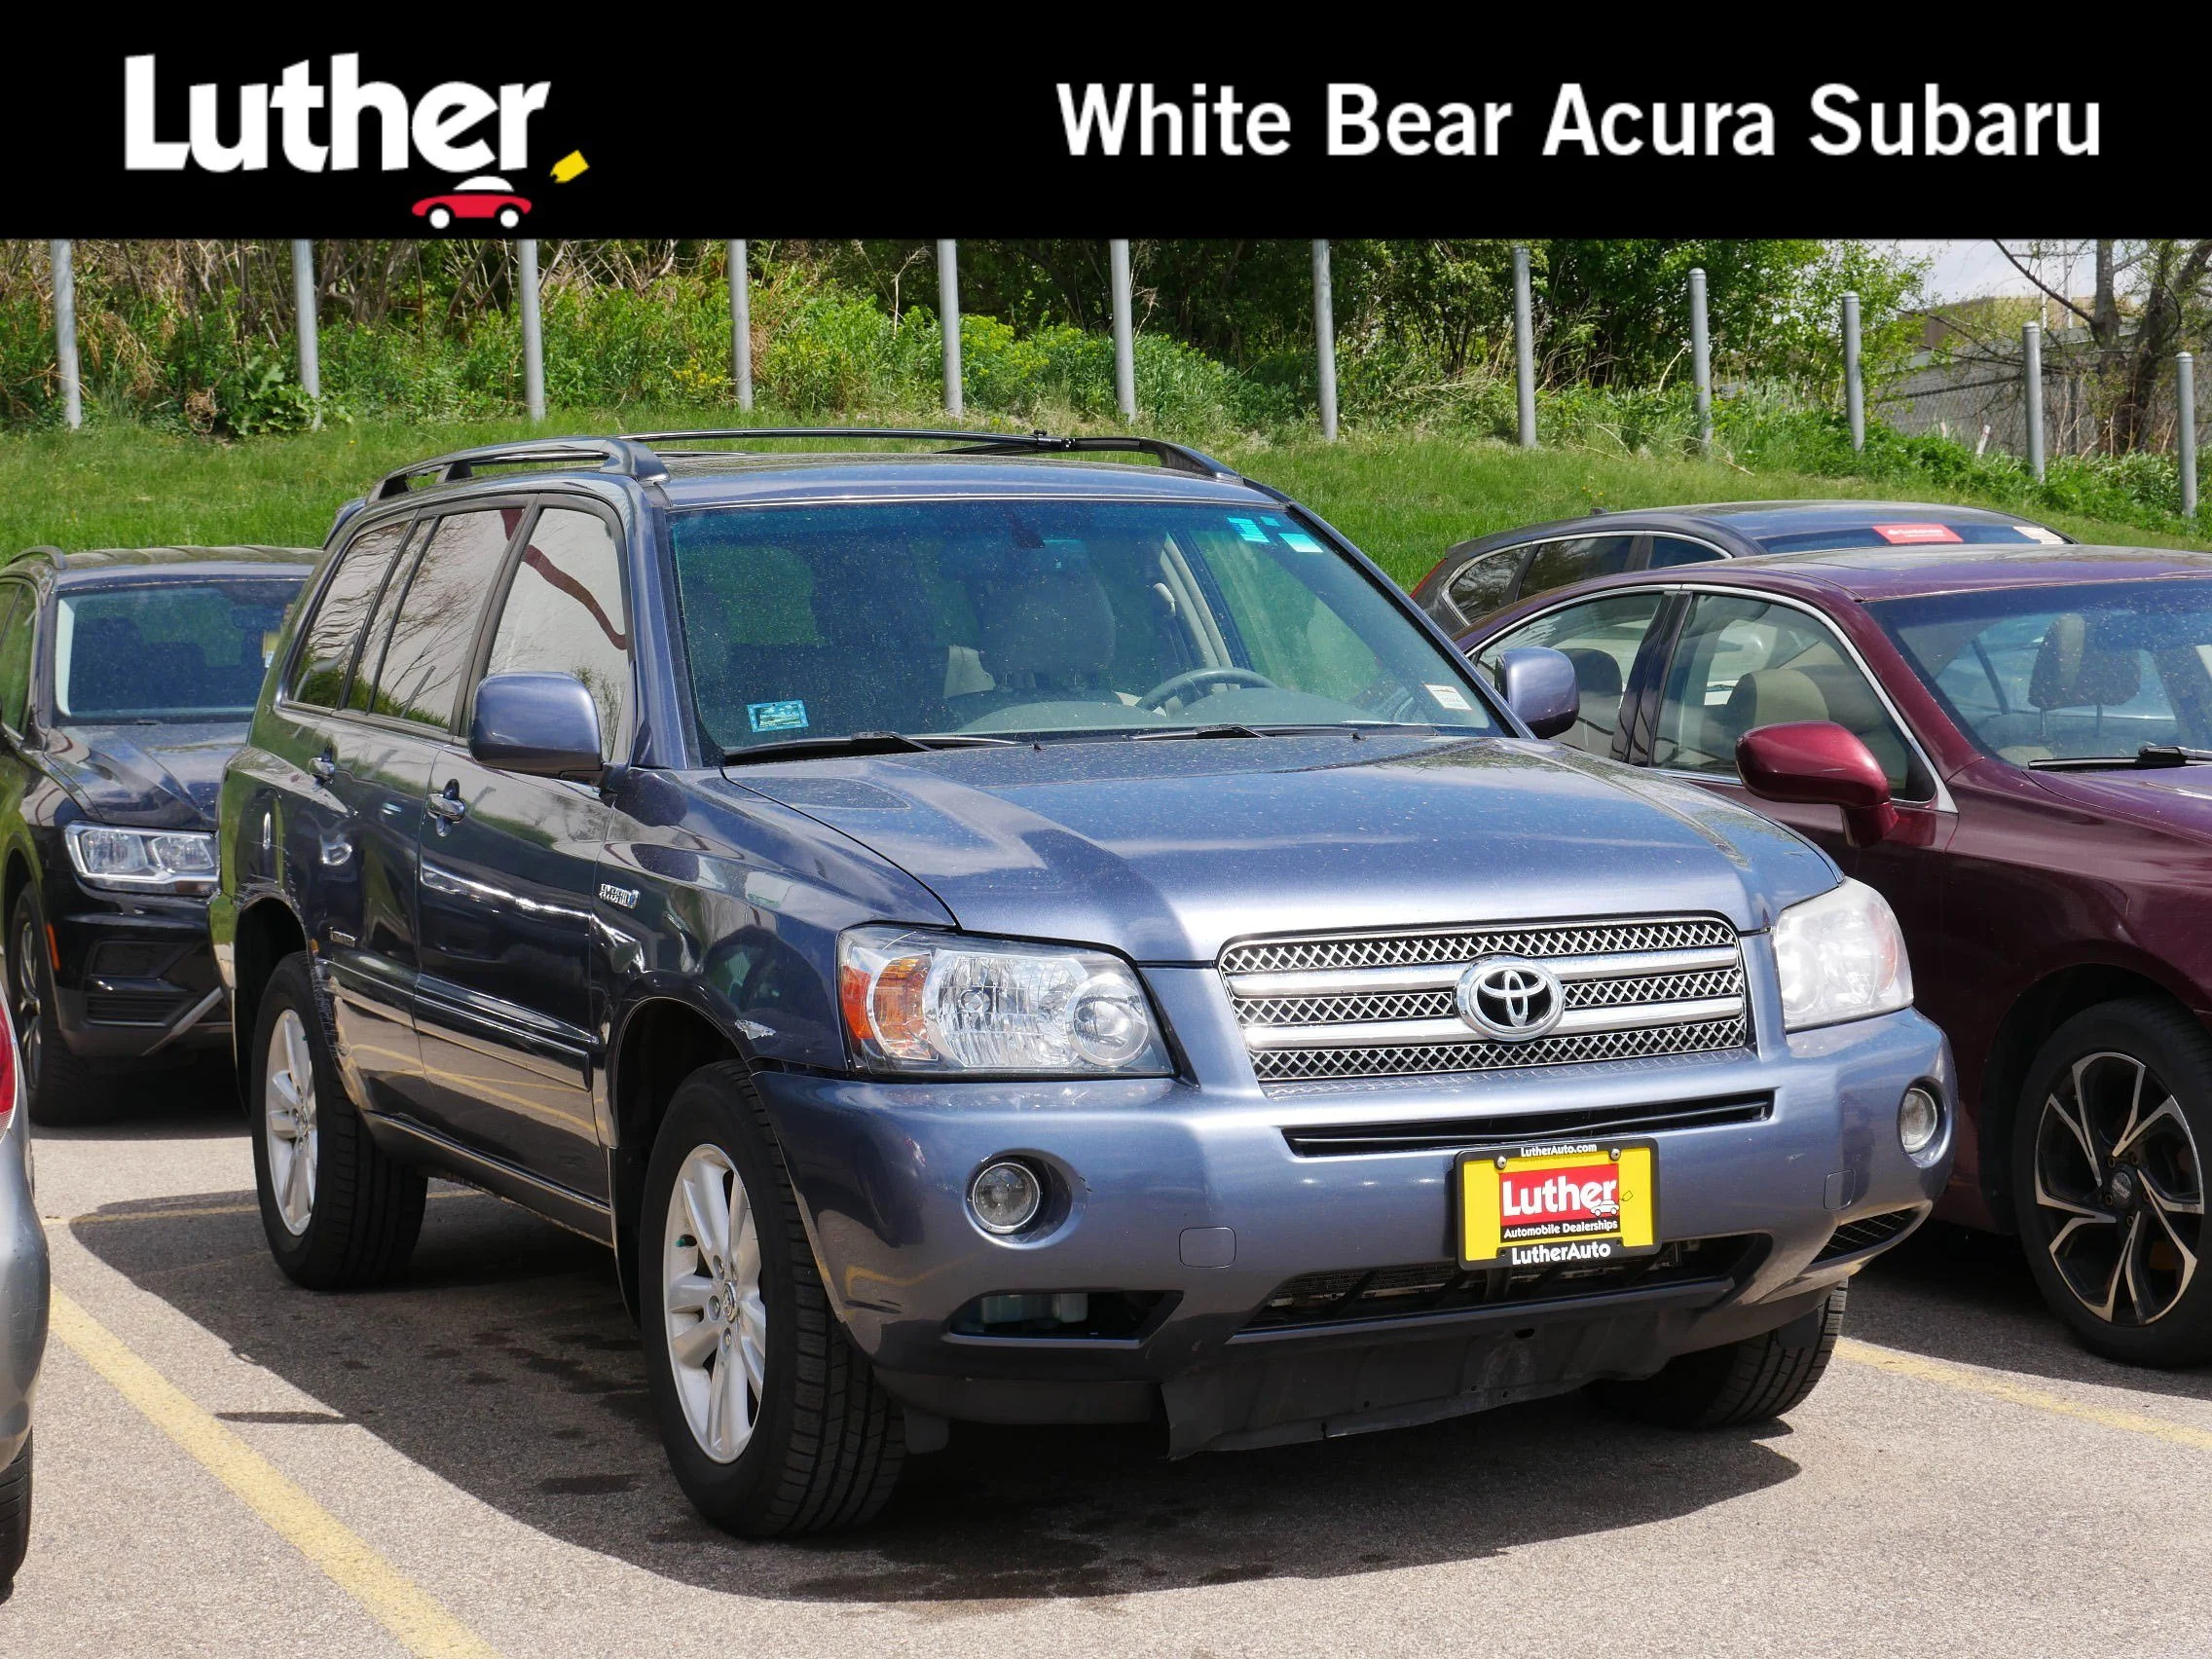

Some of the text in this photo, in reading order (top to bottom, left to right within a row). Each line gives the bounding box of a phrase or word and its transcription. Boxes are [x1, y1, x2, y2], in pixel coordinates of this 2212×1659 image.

[1521, 1143, 1598, 1158] LutherAuto.com
[1502, 1175, 1617, 1217] Luther
[1504, 1219, 1618, 1238] Automobile Dealerships
[1512, 1241, 1611, 1266] LutherAuto
